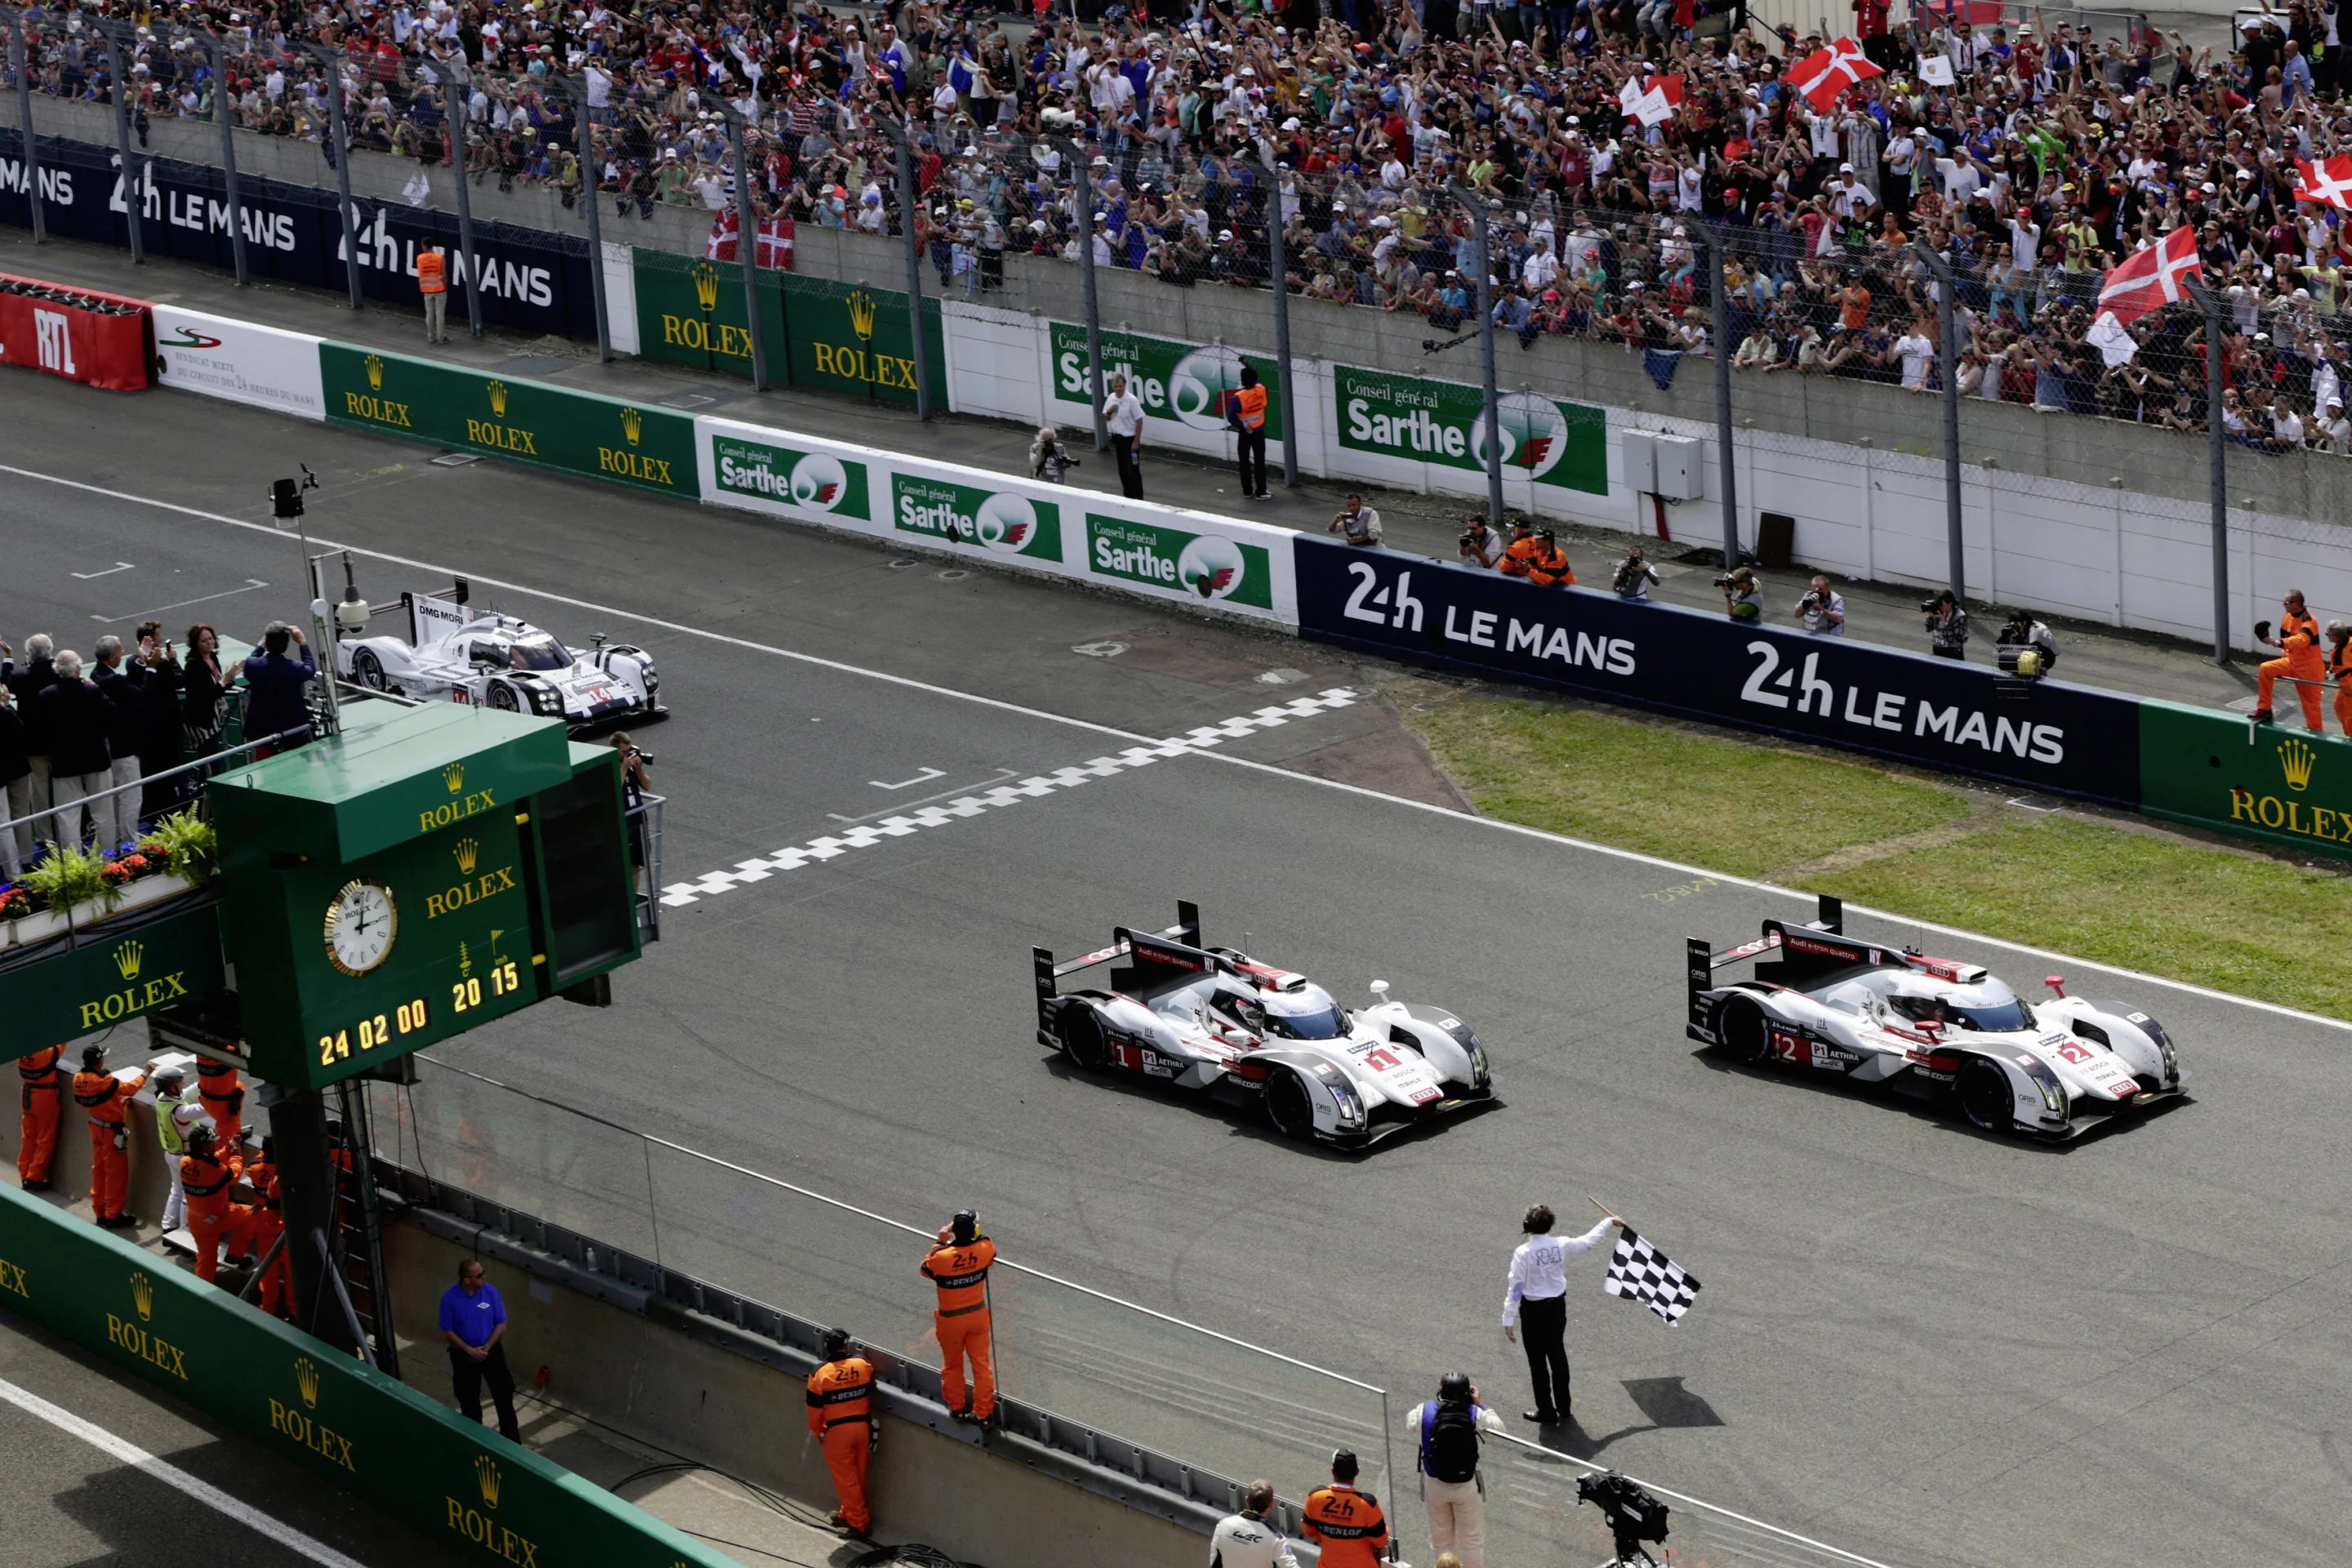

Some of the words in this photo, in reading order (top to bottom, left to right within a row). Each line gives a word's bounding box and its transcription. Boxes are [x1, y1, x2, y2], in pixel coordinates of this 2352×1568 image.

[169, 190, 203, 231] LE
[452, 248, 553, 307] MANS
[33, 307, 76, 376] RTL
[662, 314, 754, 359] ROLEX
[1058, 332, 1089, 352] Conse
[175, 351, 210, 368] SYNDICAT
[212, 359, 235, 372] MIXTE
[813, 341, 919, 391] ROLEX
[177, 367, 188, 376] DU
[189, 370, 219, 385] CIRCUIT
[221, 377, 236, 388] DES
[235, 374, 248, 391] 24
[249, 383, 279, 399] HEURES
[279, 390, 291, 401] DU
[292, 393, 316, 407] MANS
[1346, 377, 1391, 401] Conseil
[1394, 390, 1439, 409] général
[345, 391, 412, 428] ROLEX
[466, 418, 538, 456] ROLEX
[1347, 397, 1466, 457] Sarthe
[719, 443, 746, 459] Conseil
[746, 448, 773, 465] général
[597, 447, 675, 486] ROLEX
[720, 456, 790, 497] Sarthe
[898, 480, 927, 499] Conseil
[928, 487, 956, 503] général
[900, 494, 975, 537] Sarthe
[1094, 521, 1125, 540] Conseil
[1126, 530, 1157, 546] général
[1095, 537, 1176, 582] Sarthe
[419, 604, 439, 619] DMG
[441, 612, 464, 626] MORI
[1343, 561, 1424, 632] 24h
[1444, 604, 1499, 648] LE
[1505, 617, 1635, 676] MANS
[589, 687, 612, 703] 14
[1740, 640, 1834, 718] 24h
[1843, 685, 1907, 733] LE
[1914, 699, 2065, 765] MANS
[419, 788, 497, 832] ROLEX
[2229, 788, 2352, 844] ROLEX
[425, 866, 516, 920] ROLEX
[345, 905, 372, 920] ROLEX
[1138, 947, 1152, 956] Audi
[1153, 951, 1172, 963] e-tron
[1171, 956, 1194, 969] quattro
[1694, 948, 1708, 957] BOSCH
[1790, 938, 1806, 948] Audi
[1807, 943, 1829, 954] e-tron
[1829, 947, 1856, 960] quattro
[1869, 948, 1881, 965] HY
[1039, 956, 1053, 966] BOSCH
[1205, 956, 1214, 973] HY
[1038, 976, 1052, 987] ORIS
[1691, 969, 1707, 978] ORIS
[452, 978, 482, 1013] 20
[491, 962, 519, 996] 15
[79, 971, 188, 1029] ROLEX
[1443, 1019, 1457, 1029] P1
[2132, 1012, 2146, 1022] P1
[319, 1029, 350, 1067] 24
[359, 1014, 390, 1050] 02
[397, 999, 427, 1035] 00
[1116, 1045, 1129, 1067] 1
[1143, 1052, 1156, 1063] P1
[1782, 1037, 1797, 1061] 2
[1814, 1044, 1826, 1055] P1
[1830, 1050, 1860, 1062] AETHRA
[2062, 1047, 2090, 1062] 2
[1158, 1058, 1184, 1069] AETHRA
[1370, 1054, 1396, 1070] 1
[1392, 1067, 1417, 1079] BOSCH
[2089, 1061, 2109, 1072] BOSCH
[1241, 1080, 1263, 1089] EDGE
[1397, 1076, 1423, 1089] MAHLE
[1931, 1071, 1956, 1082] EDGE
[2096, 1070, 2118, 1081] MAHLE
[1316, 1103, 1331, 1112] ORIS
[2018, 1094, 2036, 1103] ORIS
[952, 1251, 978, 1268] 24h
[952, 1272, 983, 1286] DUNLOP
[106, 1312, 189, 1381] ROLEX
[836, 1366, 859, 1382] 24h
[838, 1388, 866, 1401] DUNLOP
[269, 1397, 357, 1472] ROLEX
[1321, 1495, 1354, 1517] 24h
[1330, 1514, 1352, 1522] MANS
[445, 1495, 538, 1568] ROLEX
[1232, 1530, 1263, 1544] WEC
[1324, 1526, 1362, 1537] DUNLOP
